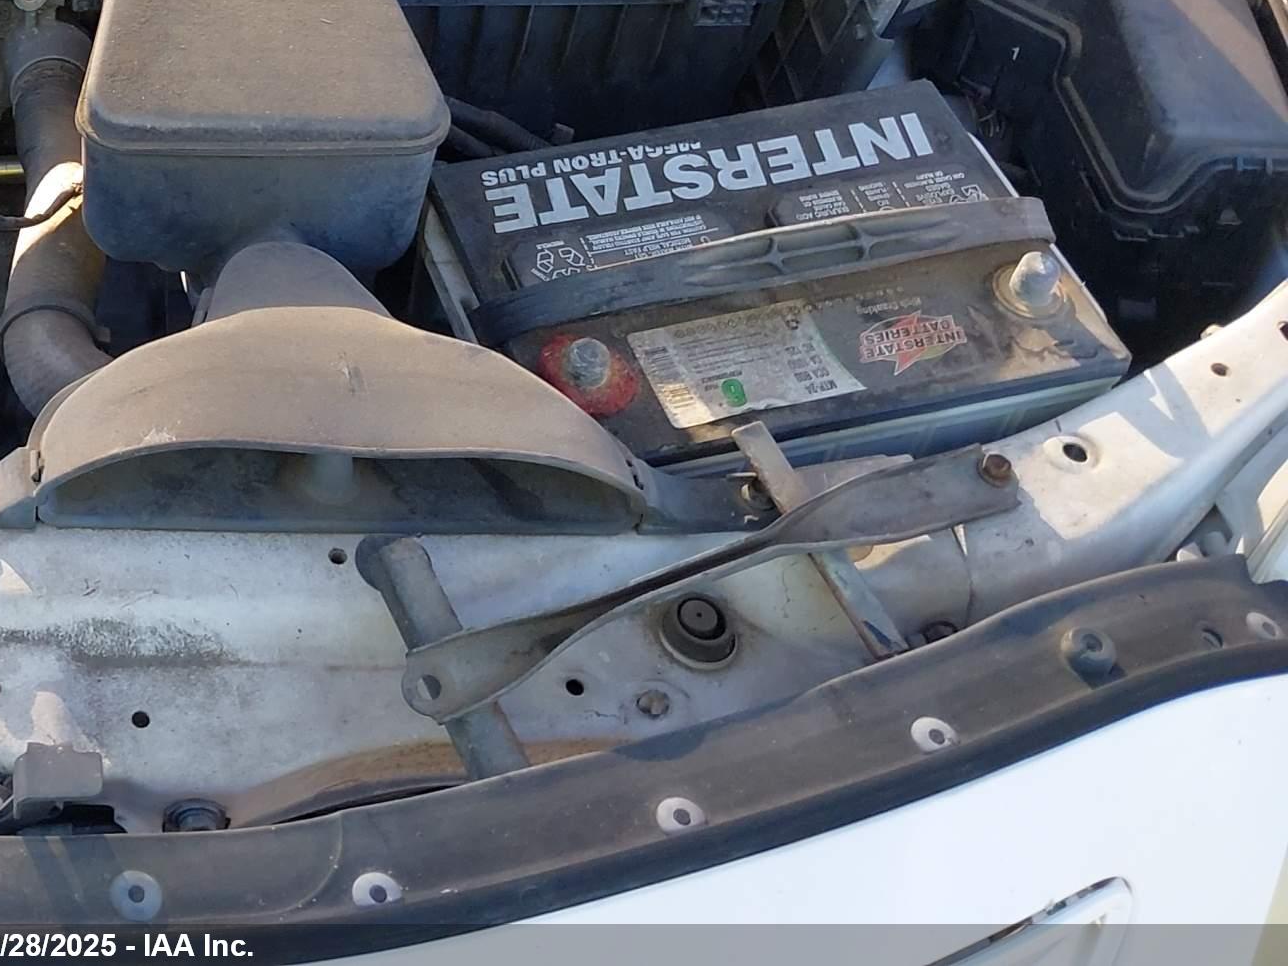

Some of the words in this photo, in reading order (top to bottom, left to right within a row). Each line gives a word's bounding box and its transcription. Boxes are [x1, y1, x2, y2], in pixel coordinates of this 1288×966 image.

[480, 162, 545, 186] PLUS
[483, 113, 934, 231] INTERSTATE
[863, 320, 950, 345] BATTERIES
[863, 331, 963, 357] INTERSTATE
